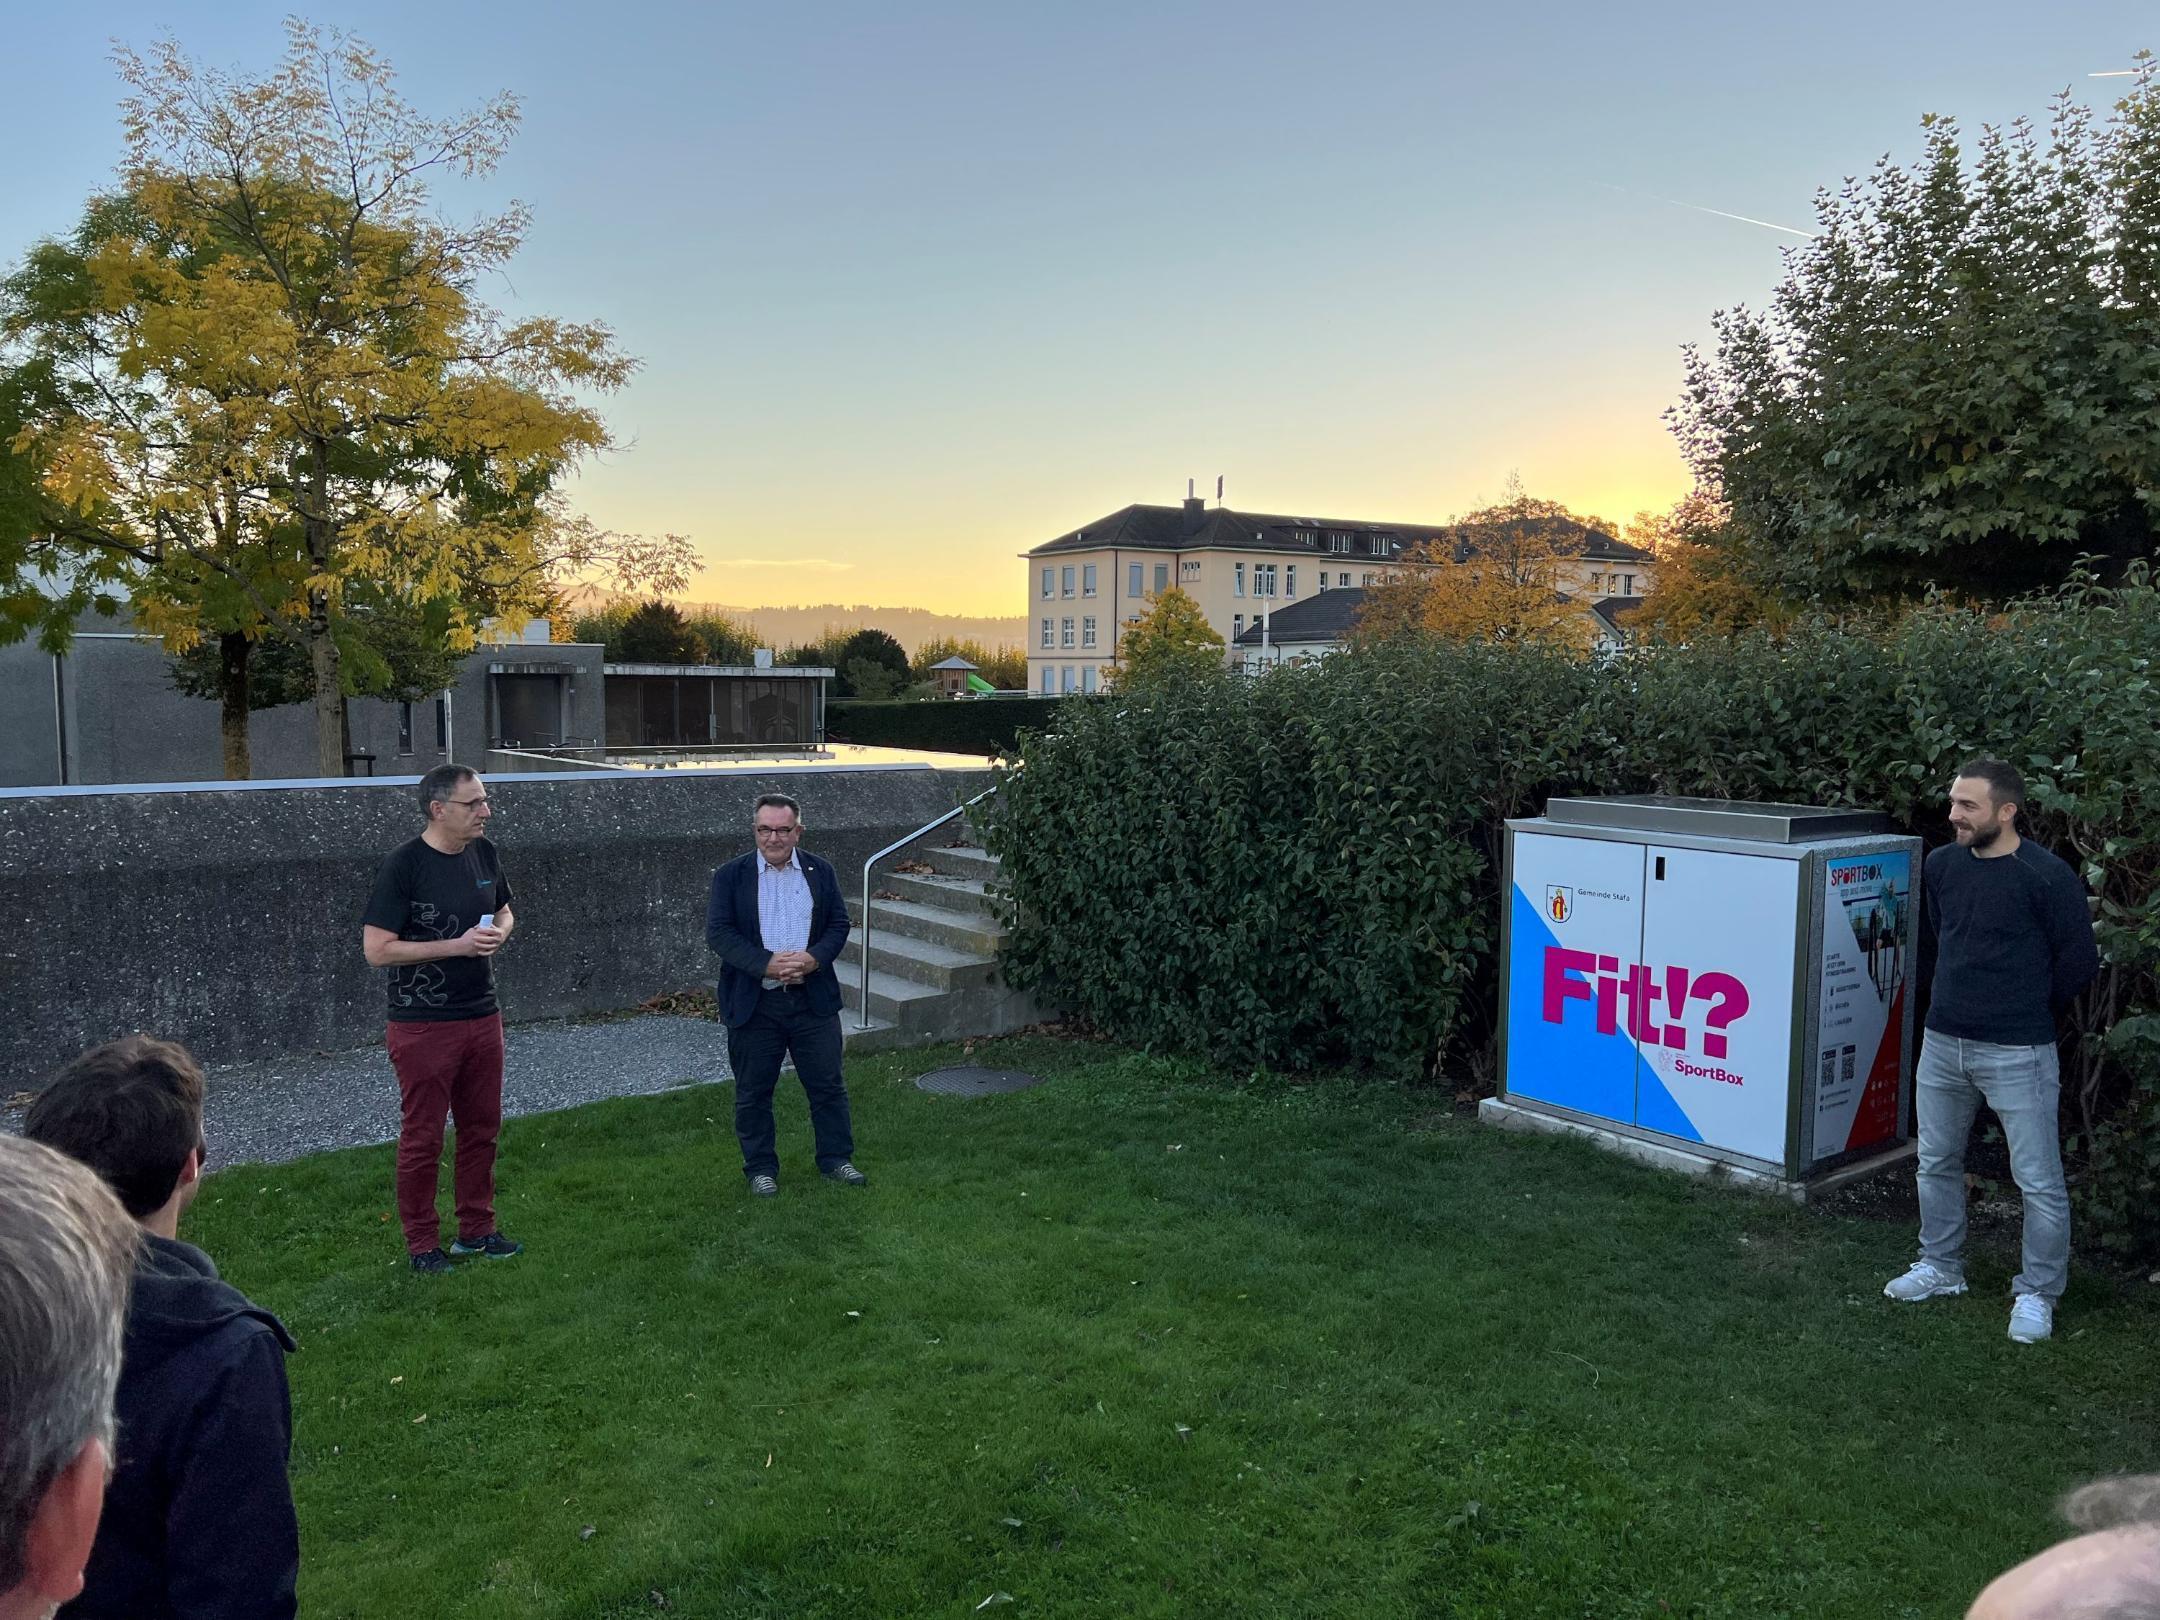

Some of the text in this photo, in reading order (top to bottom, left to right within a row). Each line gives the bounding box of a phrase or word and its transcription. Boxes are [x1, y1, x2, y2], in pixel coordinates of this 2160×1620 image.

[1831, 863, 1883, 886] SPORTBOX
[1577, 888, 1611, 899] Gemeinde
[1542, 946, 1750, 1060] Fit!?
[1674, 1059, 1744, 1086] SportBox
